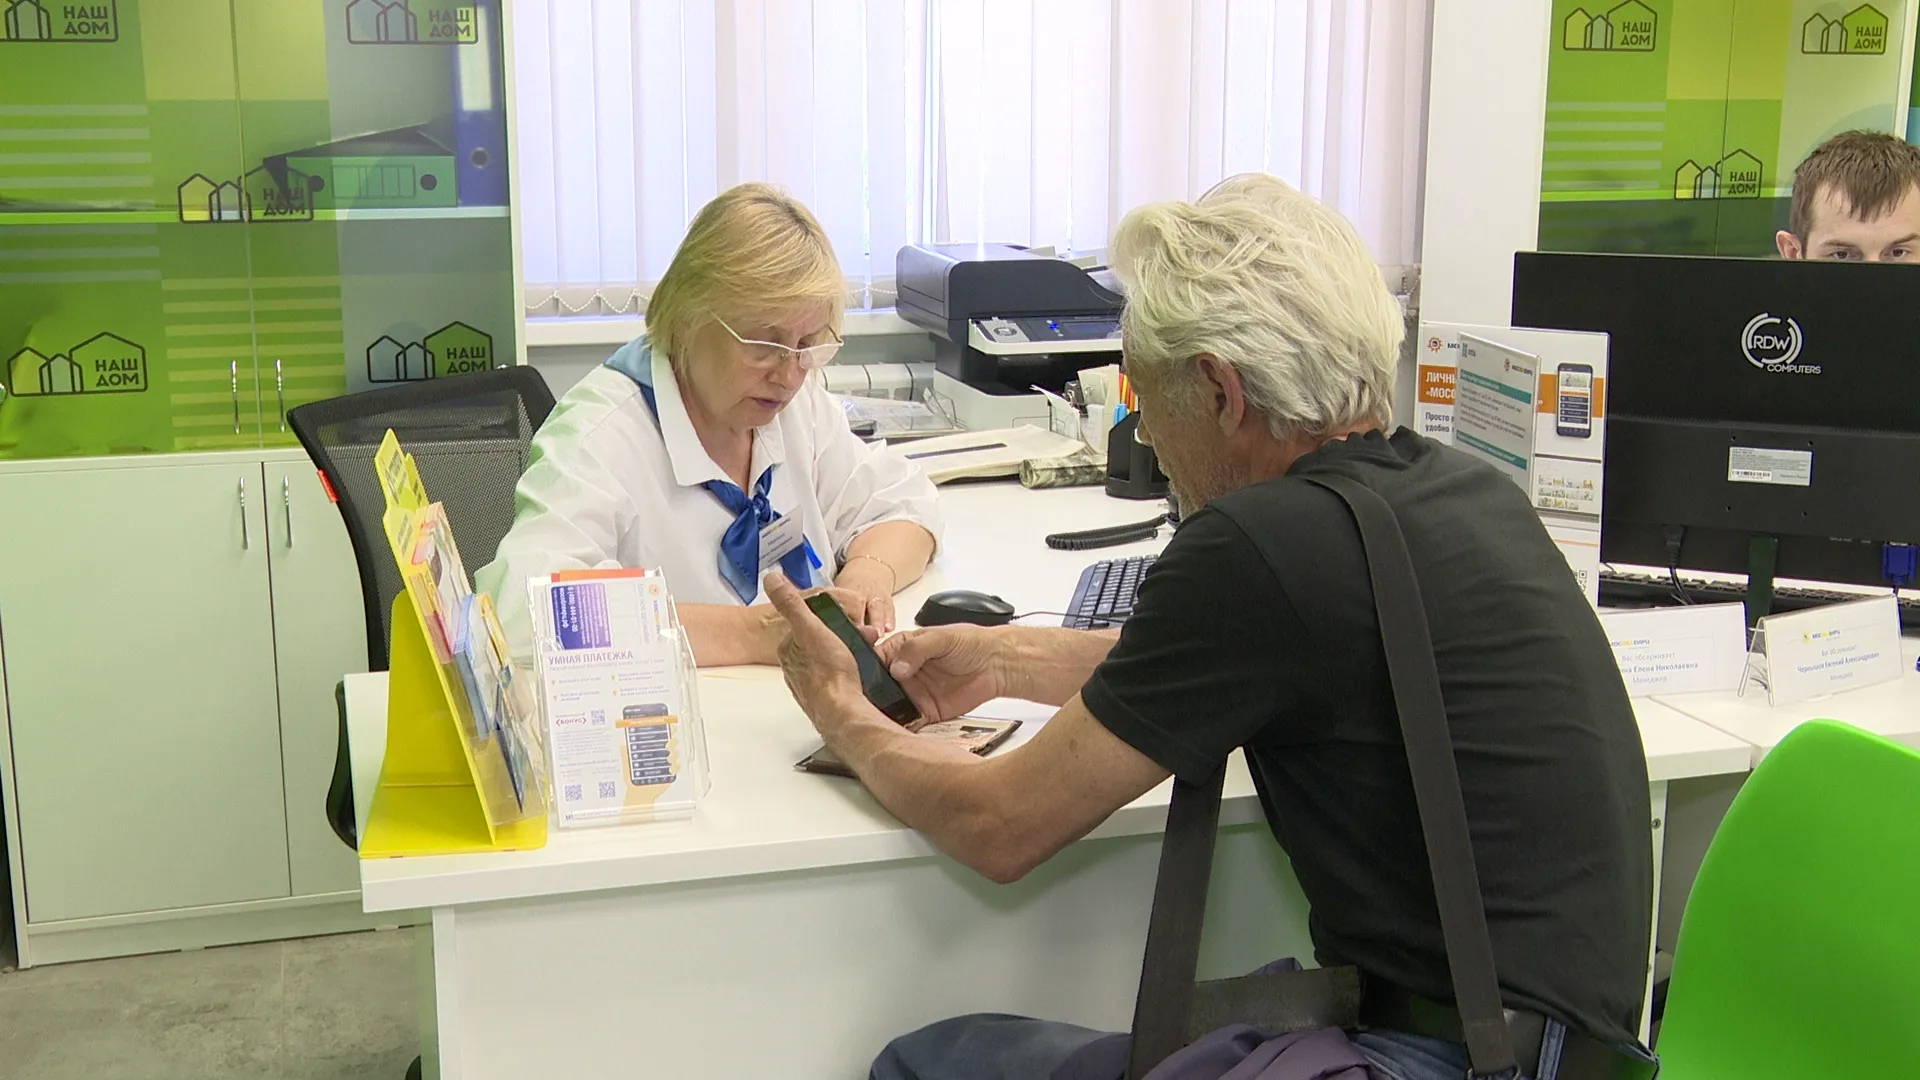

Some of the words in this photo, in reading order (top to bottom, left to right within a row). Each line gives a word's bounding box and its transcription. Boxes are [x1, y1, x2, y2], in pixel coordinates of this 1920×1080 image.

[63, 5, 108, 19] НАШ
[428, 9, 470, 22] НАШ
[64, 21, 109, 35] ДОМ
[429, 23, 471, 37] ДОМ
[1622, 21, 1652, 33] НАШ
[1856, 26, 1883, 37] НАШ
[1621, 34, 1651, 46] ДОМ
[1854, 38, 1882, 49] ДОМ
[1730, 171, 1757, 182] НАШ
[1728, 183, 1756, 195] ДОМ
[1753, 335, 1790, 350] RDW
[446, 347, 486, 359] НАШ
[95, 358, 138, 372] НАШ
[446, 360, 486, 374] ДОМ
[1766, 364, 1822, 375] COMPUTERS
[96, 372, 139, 387] ДОМ
[1426, 386, 1457, 400] «МОСО
[1425, 412, 1450, 422] Просто
[1425, 424, 1450, 434] удобно
[548, 654, 581, 666] УМНАЯ
[583, 650, 634, 664] ПЛАТЕЖКА
[1634, 652, 1676, 662] обслуживает
[1825, 659, 1844, 669] Евгений
[1844, 652, 1880, 665] Александрович
[1633, 664, 1655, 674] Елена
[1655, 661, 1699, 673] Николаевна
[1632, 675, 1668, 685] Менеджер
